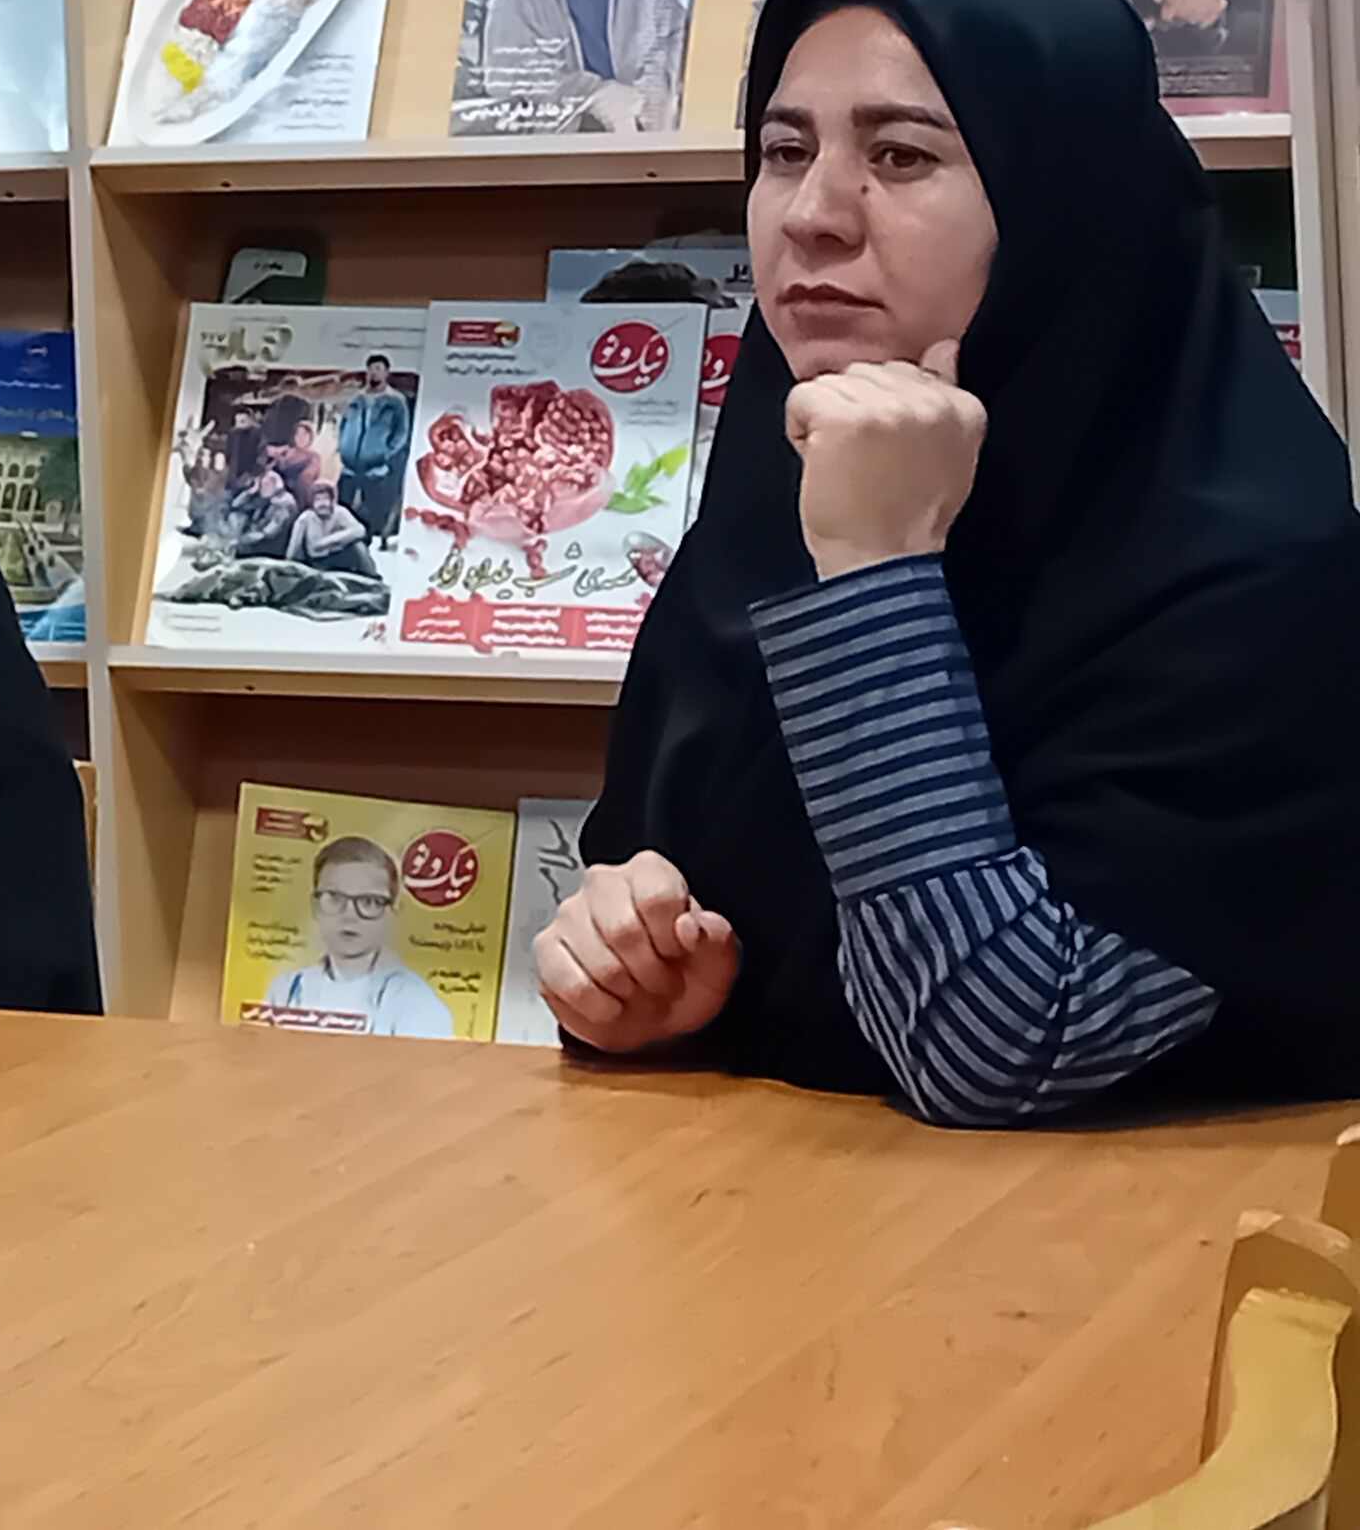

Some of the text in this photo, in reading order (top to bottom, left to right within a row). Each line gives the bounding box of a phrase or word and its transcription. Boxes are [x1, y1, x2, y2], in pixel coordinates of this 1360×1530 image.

[593, 328, 666, 386] نیک
[598, 333, 620, 365] نو
[619, 346, 632, 366] و
[403, 842, 475, 899] نیک و نو
